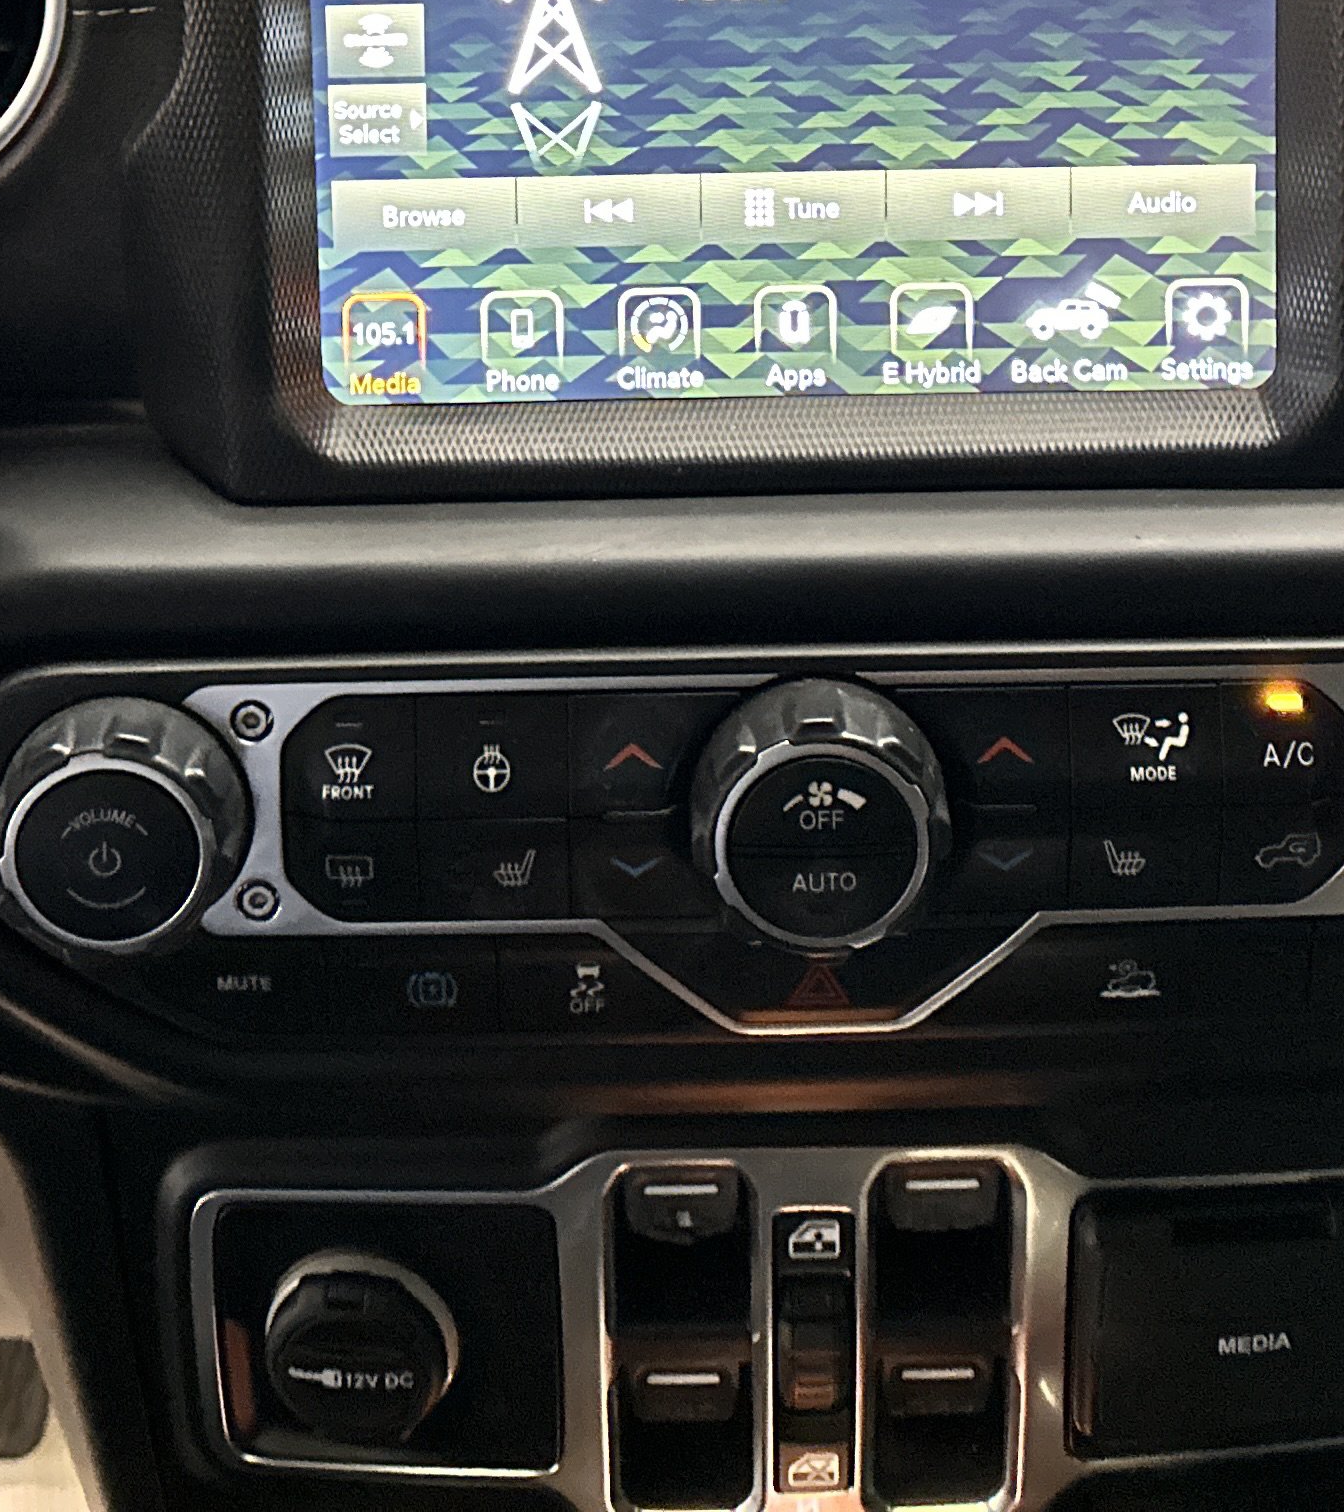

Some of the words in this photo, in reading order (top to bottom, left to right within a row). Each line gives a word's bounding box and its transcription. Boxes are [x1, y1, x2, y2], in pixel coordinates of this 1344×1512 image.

[334, 101, 402, 121] Source
[339, 125, 400, 145] Select
[783, 197, 840, 219] Tune
[1128, 191, 1197, 214] Audio
[383, 204, 465, 228] Browse
[353, 322, 415, 345] 105.1
[486, 368, 560, 392] Phone
[617, 365, 704, 389] Climate
[766, 363, 826, 390] Apps
[883, 364, 899, 383] E
[905, 359, 982, 389] Hybrid
[1011, 358, 1068, 383] Back
[1074, 360, 1127, 382] Cam
[1160, 356, 1254, 385] Settings
[350, 371, 422, 395] Media
[1263, 743, 1314, 767] A/C
[1130, 765, 1176, 781] MODE
[321, 784, 374, 800] FRONT
[68, 808, 137, 830] VOLUME
[799, 811, 845, 830] OFF
[792, 872, 857, 893] AUTO
[217, 975, 272, 992] MUTE
[570, 999, 605, 1014] OFF
[1218, 1331, 1292, 1355] MEDIA
[345, 1373, 378, 1389] 12V
[385, 1372, 414, 1388] DC
